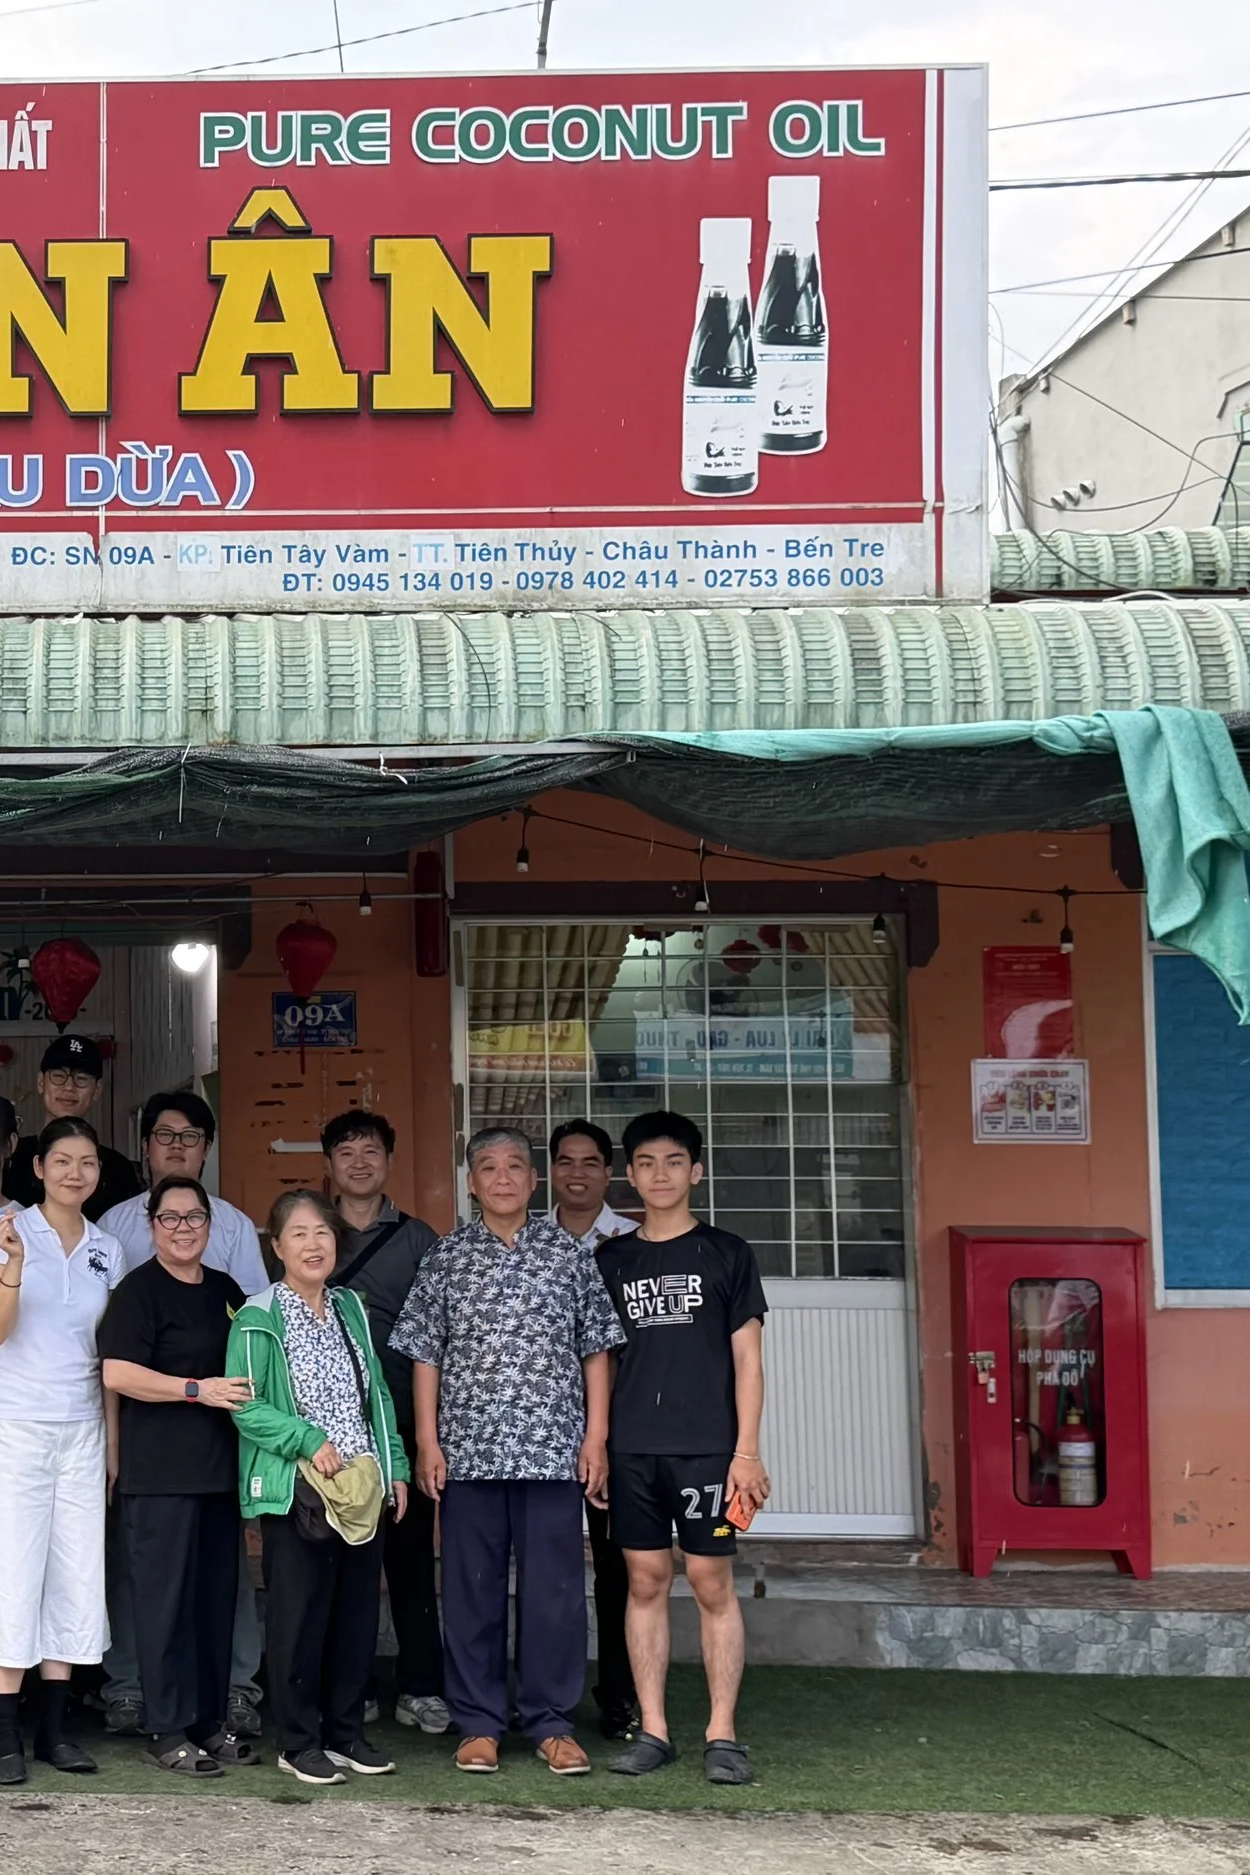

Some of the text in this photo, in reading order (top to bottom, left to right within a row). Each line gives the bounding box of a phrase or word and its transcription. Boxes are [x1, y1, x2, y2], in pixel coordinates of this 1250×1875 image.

[199, 99, 886, 169] PURE COCONUT OIL
[178, 185, 554, 417] ÂN
[11, 546, 55, 566] ĐC:
[65, 546, 100, 565] SN
[109, 546, 155, 565] 09A
[221, 545, 273, 564] Tiên
[282, 545, 326, 569] Tây
[335, 544, 389, 564] Vàm
[455, 543, 507, 562] Tiên
[515, 542, 577, 566] Thủy
[603, 540, 669, 561] Châu
[678, 540, 757, 560] Thành
[784, 536, 833, 559] Bến
[844, 538, 885, 558] Tre
[282, 573, 323, 592] ĐT:
[332, 573, 390, 592] 0945
[399, 573, 441, 592] 134
[450, 572, 493, 591] 019
[516, 571, 574, 590] 0978
[583, 570, 626, 589] 402
[635, 570, 678, 589] 414
[704, 569, 778, 589] 02753
[787, 568, 831, 588] 866
[840, 568, 884, 587] 003
[623, 1274, 702, 1301] NEVER
[627, 1294, 703, 1319] GIVE UP
[680, 1483, 724, 1519] 27
